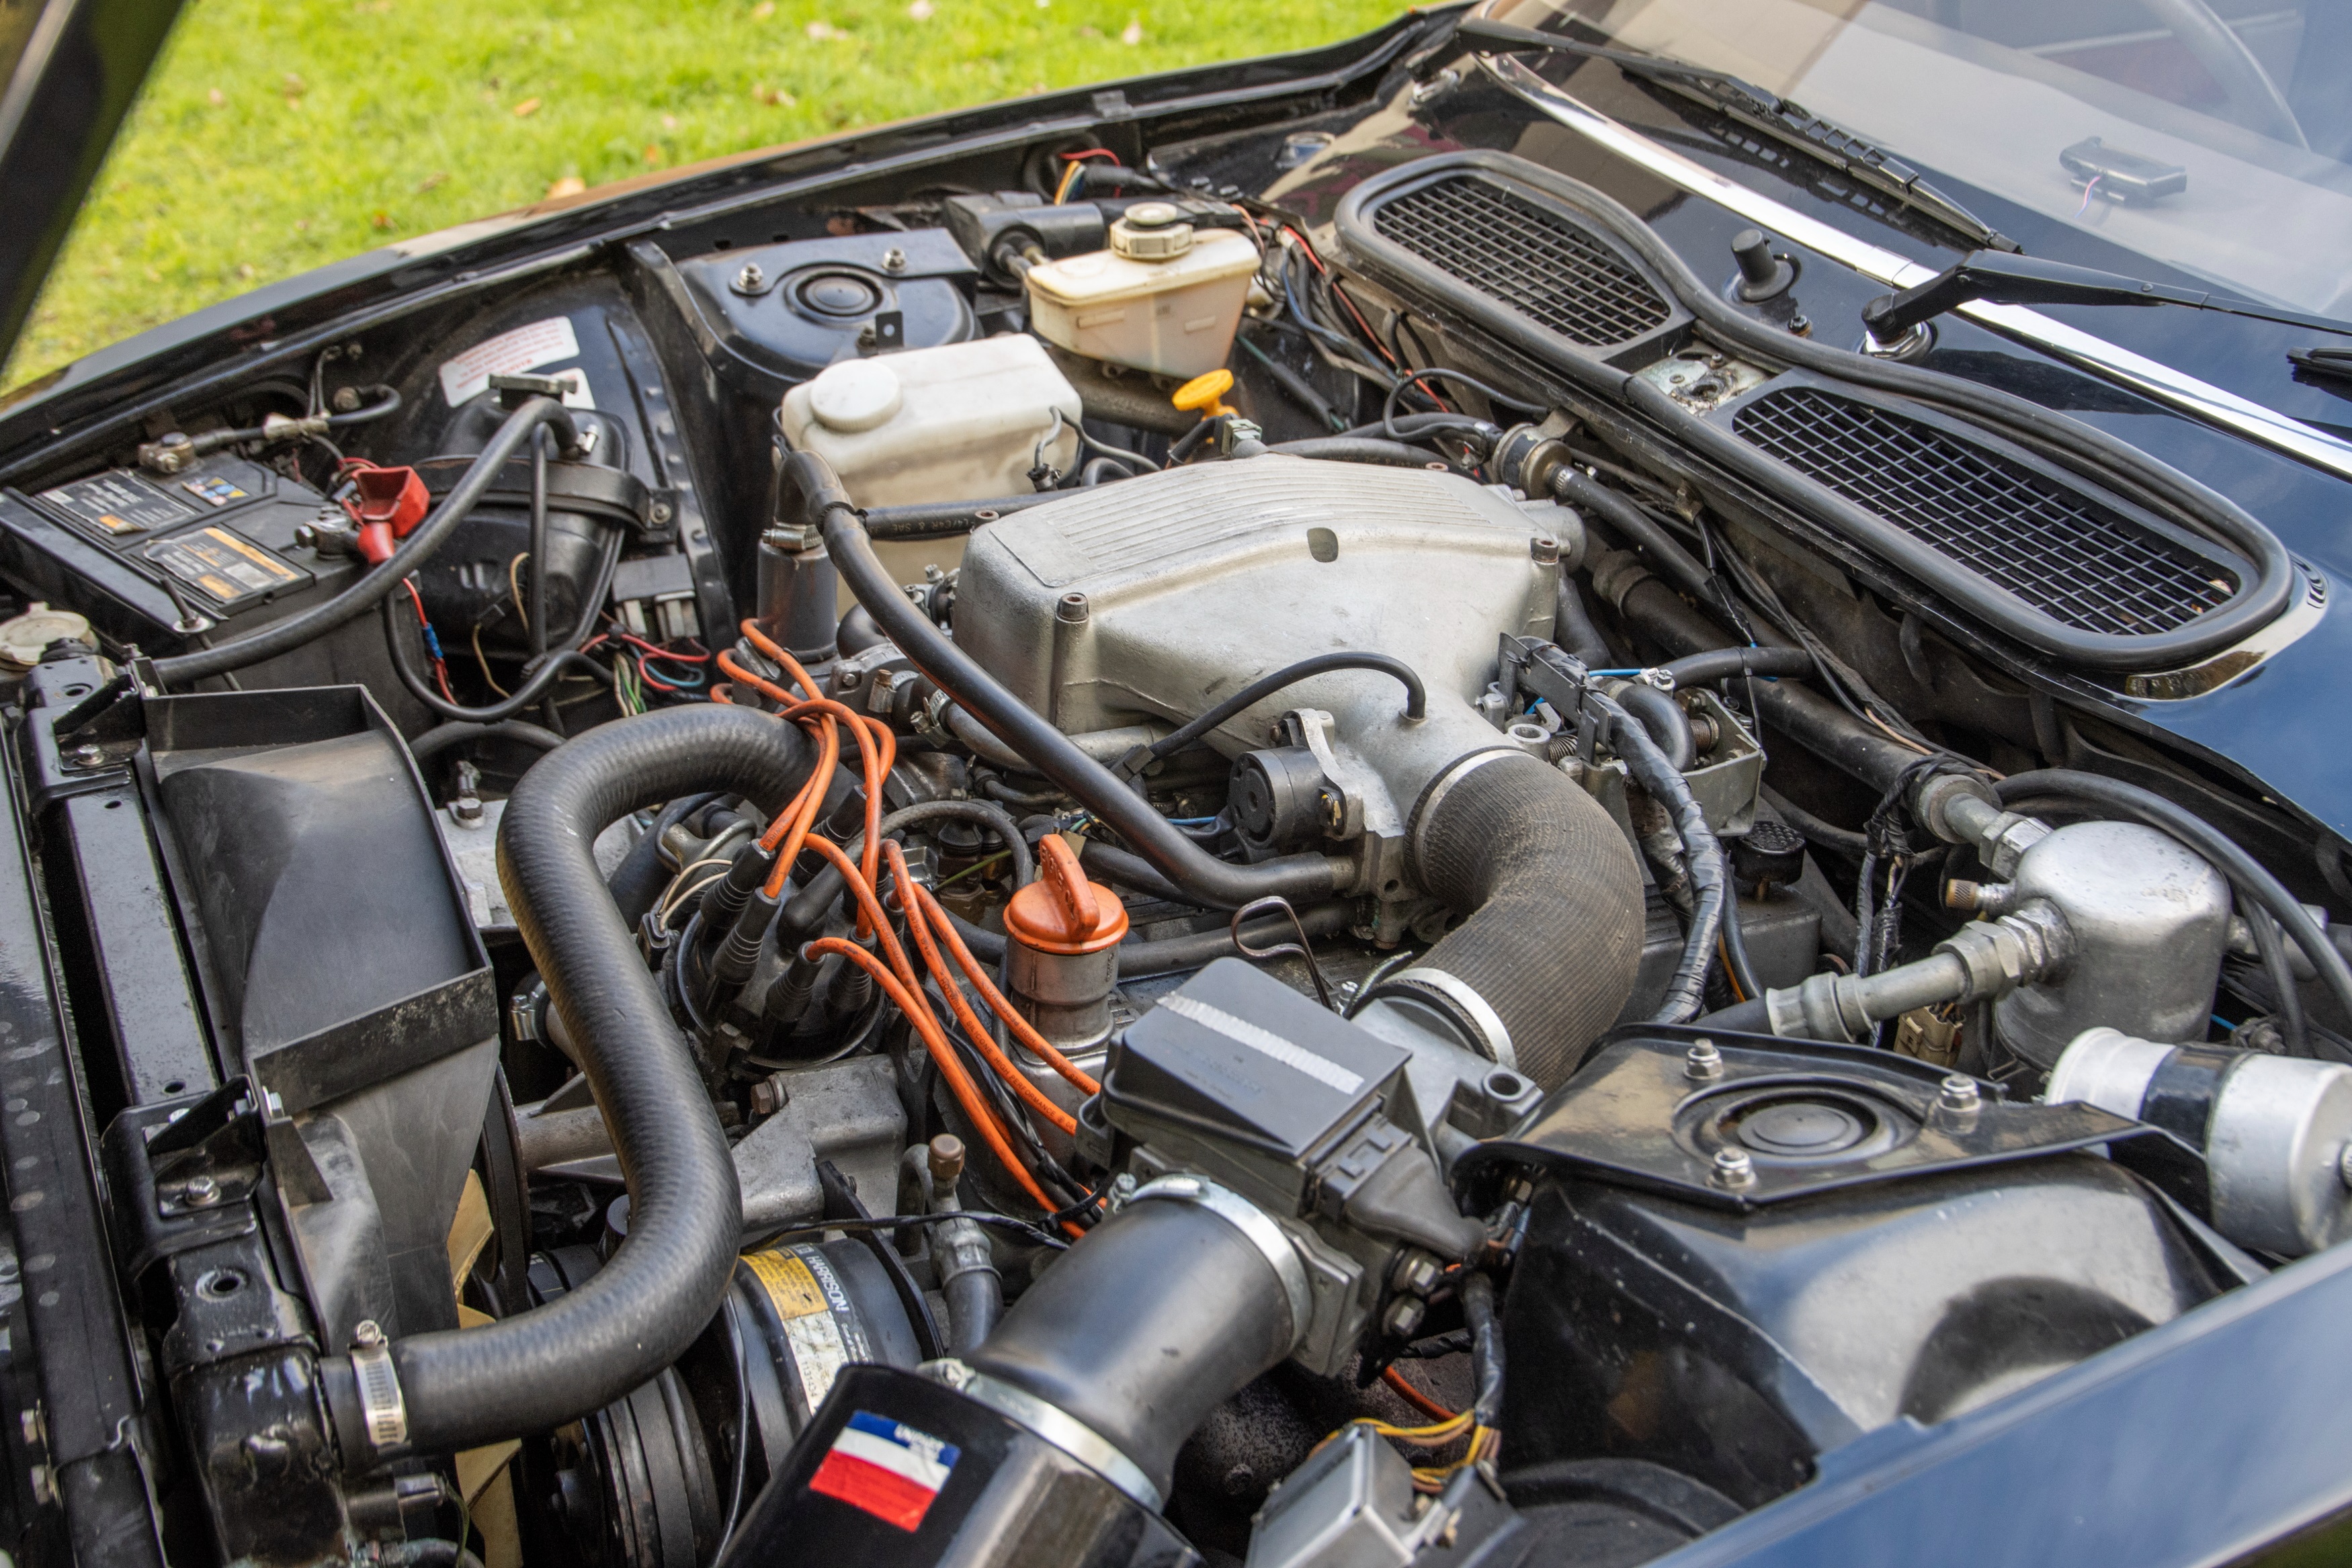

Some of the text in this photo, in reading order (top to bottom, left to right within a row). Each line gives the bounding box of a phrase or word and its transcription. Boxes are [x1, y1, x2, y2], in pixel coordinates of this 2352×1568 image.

[1020, 1027, 1036, 1042] HIGH
[966, 1020, 993, 1054] SILICONE
[994, 1057, 1010, 1076] HIGH
[1011, 1075, 1056, 1117] PERFORMANCE
[1069, 1074, 1096, 1095] OTWIRES
[806, 1256, 850, 1311] HARRISON
